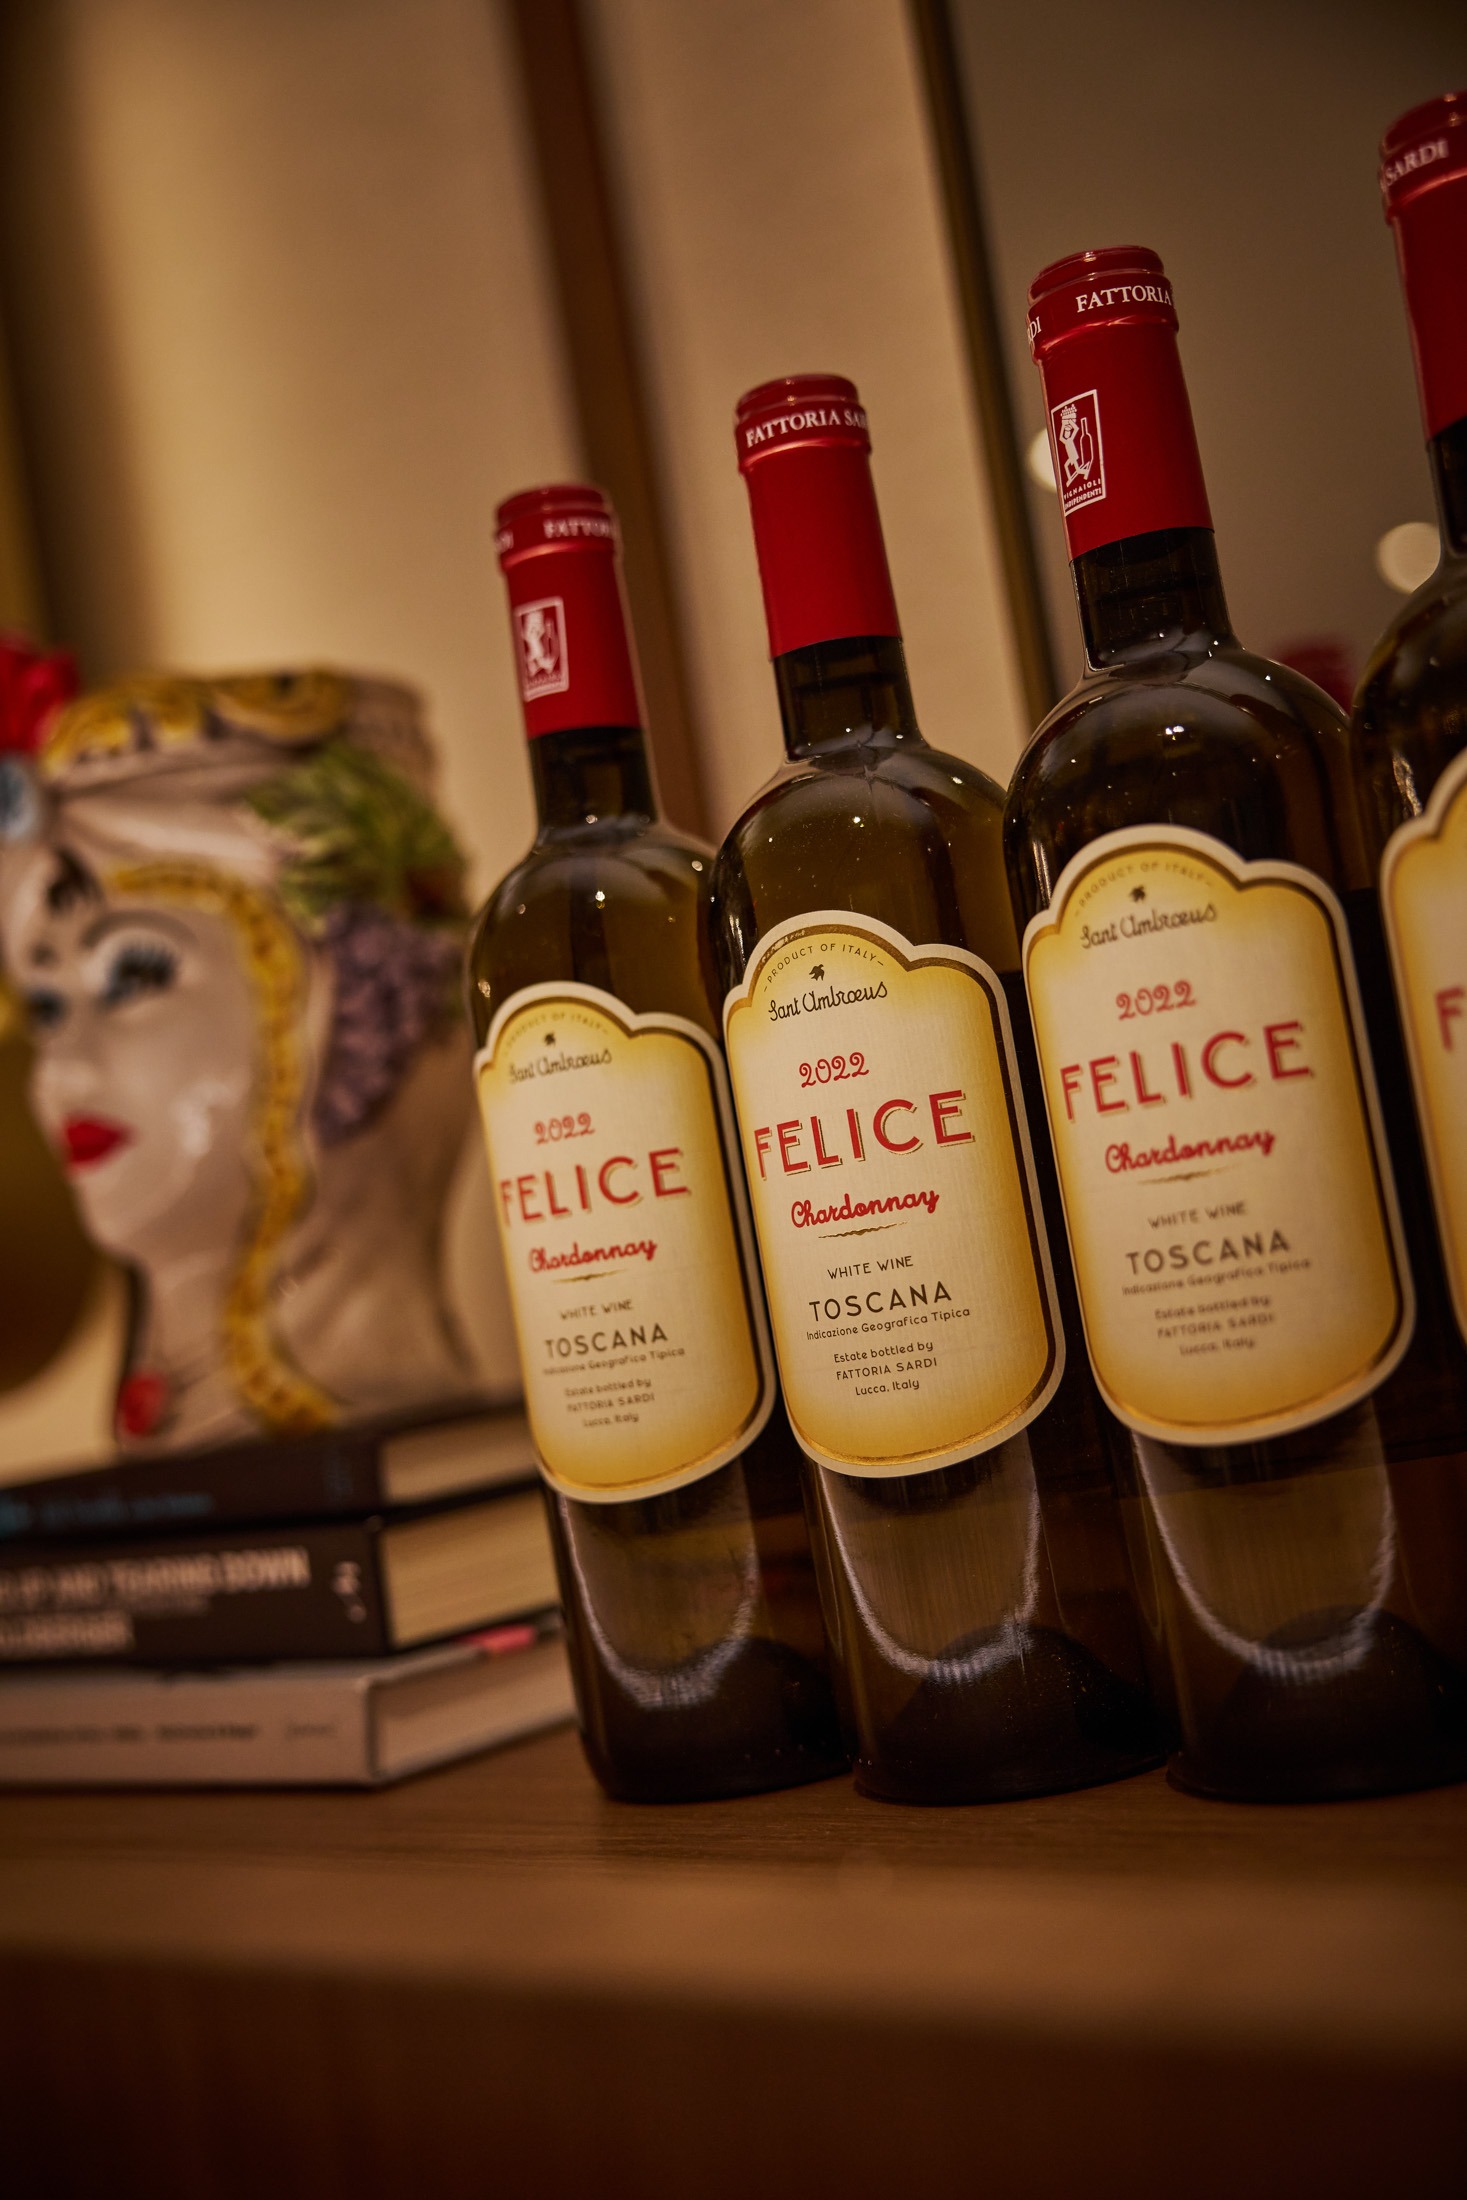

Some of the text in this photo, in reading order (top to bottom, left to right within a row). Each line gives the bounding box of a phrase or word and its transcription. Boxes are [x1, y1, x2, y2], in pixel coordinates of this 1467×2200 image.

[1385, 137, 1449, 186] SARDI
[1076, 285, 1172, 313] FATTORIA
[745, 409, 841, 448] FATTORIA
[1080, 924, 1118, 949] Sant
[767, 943, 876, 982] PRODUCT OF ITALY
[768, 998, 801, 1021] Sant
[1116, 979, 1196, 1021] 2022
[799, 1052, 869, 1088] 2022
[1060, 1021, 1314, 1122] FELICE
[534, 1112, 595, 1145] 2022
[754, 1089, 976, 1181] FELICE
[1105, 1129, 1275, 1174] Chardonnay
[500, 1147, 691, 1227] FELICE
[791, 1190, 939, 1228] Chardonnay
[1149, 1201, 1246, 1228] WHITE WINE
[530, 1239, 657, 1273] Chardonnay
[827, 1255, 914, 1280] WHITE WINE
[1126, 1229, 1290, 1276] TOSCANA
[560, 1299, 634, 1321] WHITE WINE
[808, 1281, 952, 1322] TOSCANA
[545, 1322, 668, 1359] TOSCANA
[806, 1307, 970, 1341] Indicazione Geografica Tipica
[588, 1354, 647, 1369] Geografica
[650, 1347, 686, 1360] Tipica
[833, 1340, 934, 1363] Estate bottled by
[836, 1357, 938, 1381] FATTORIA SARDI
[617, 1393, 655, 1406] SARDI
[855, 1378, 920, 1396] Lucca, Italy
